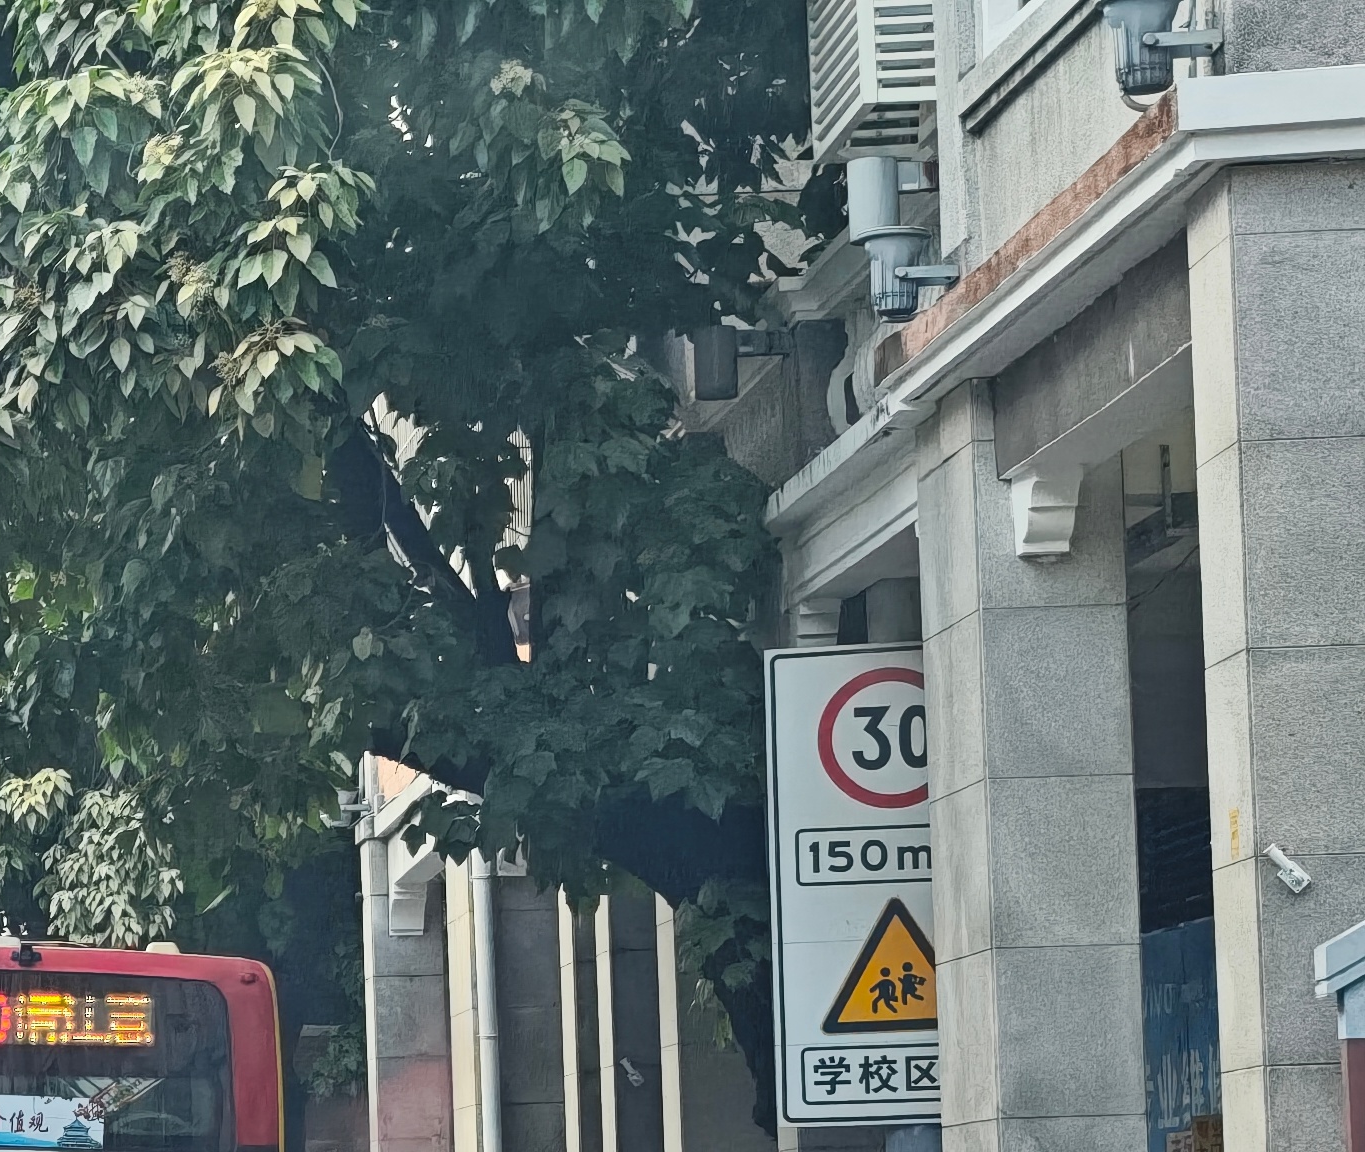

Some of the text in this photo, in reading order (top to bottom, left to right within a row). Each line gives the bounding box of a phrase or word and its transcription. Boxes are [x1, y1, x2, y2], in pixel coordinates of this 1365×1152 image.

[851, 704, 927, 771] 30
[808, 839, 931, 874] 150m
[813, 1055, 940, 1095] 学校区
